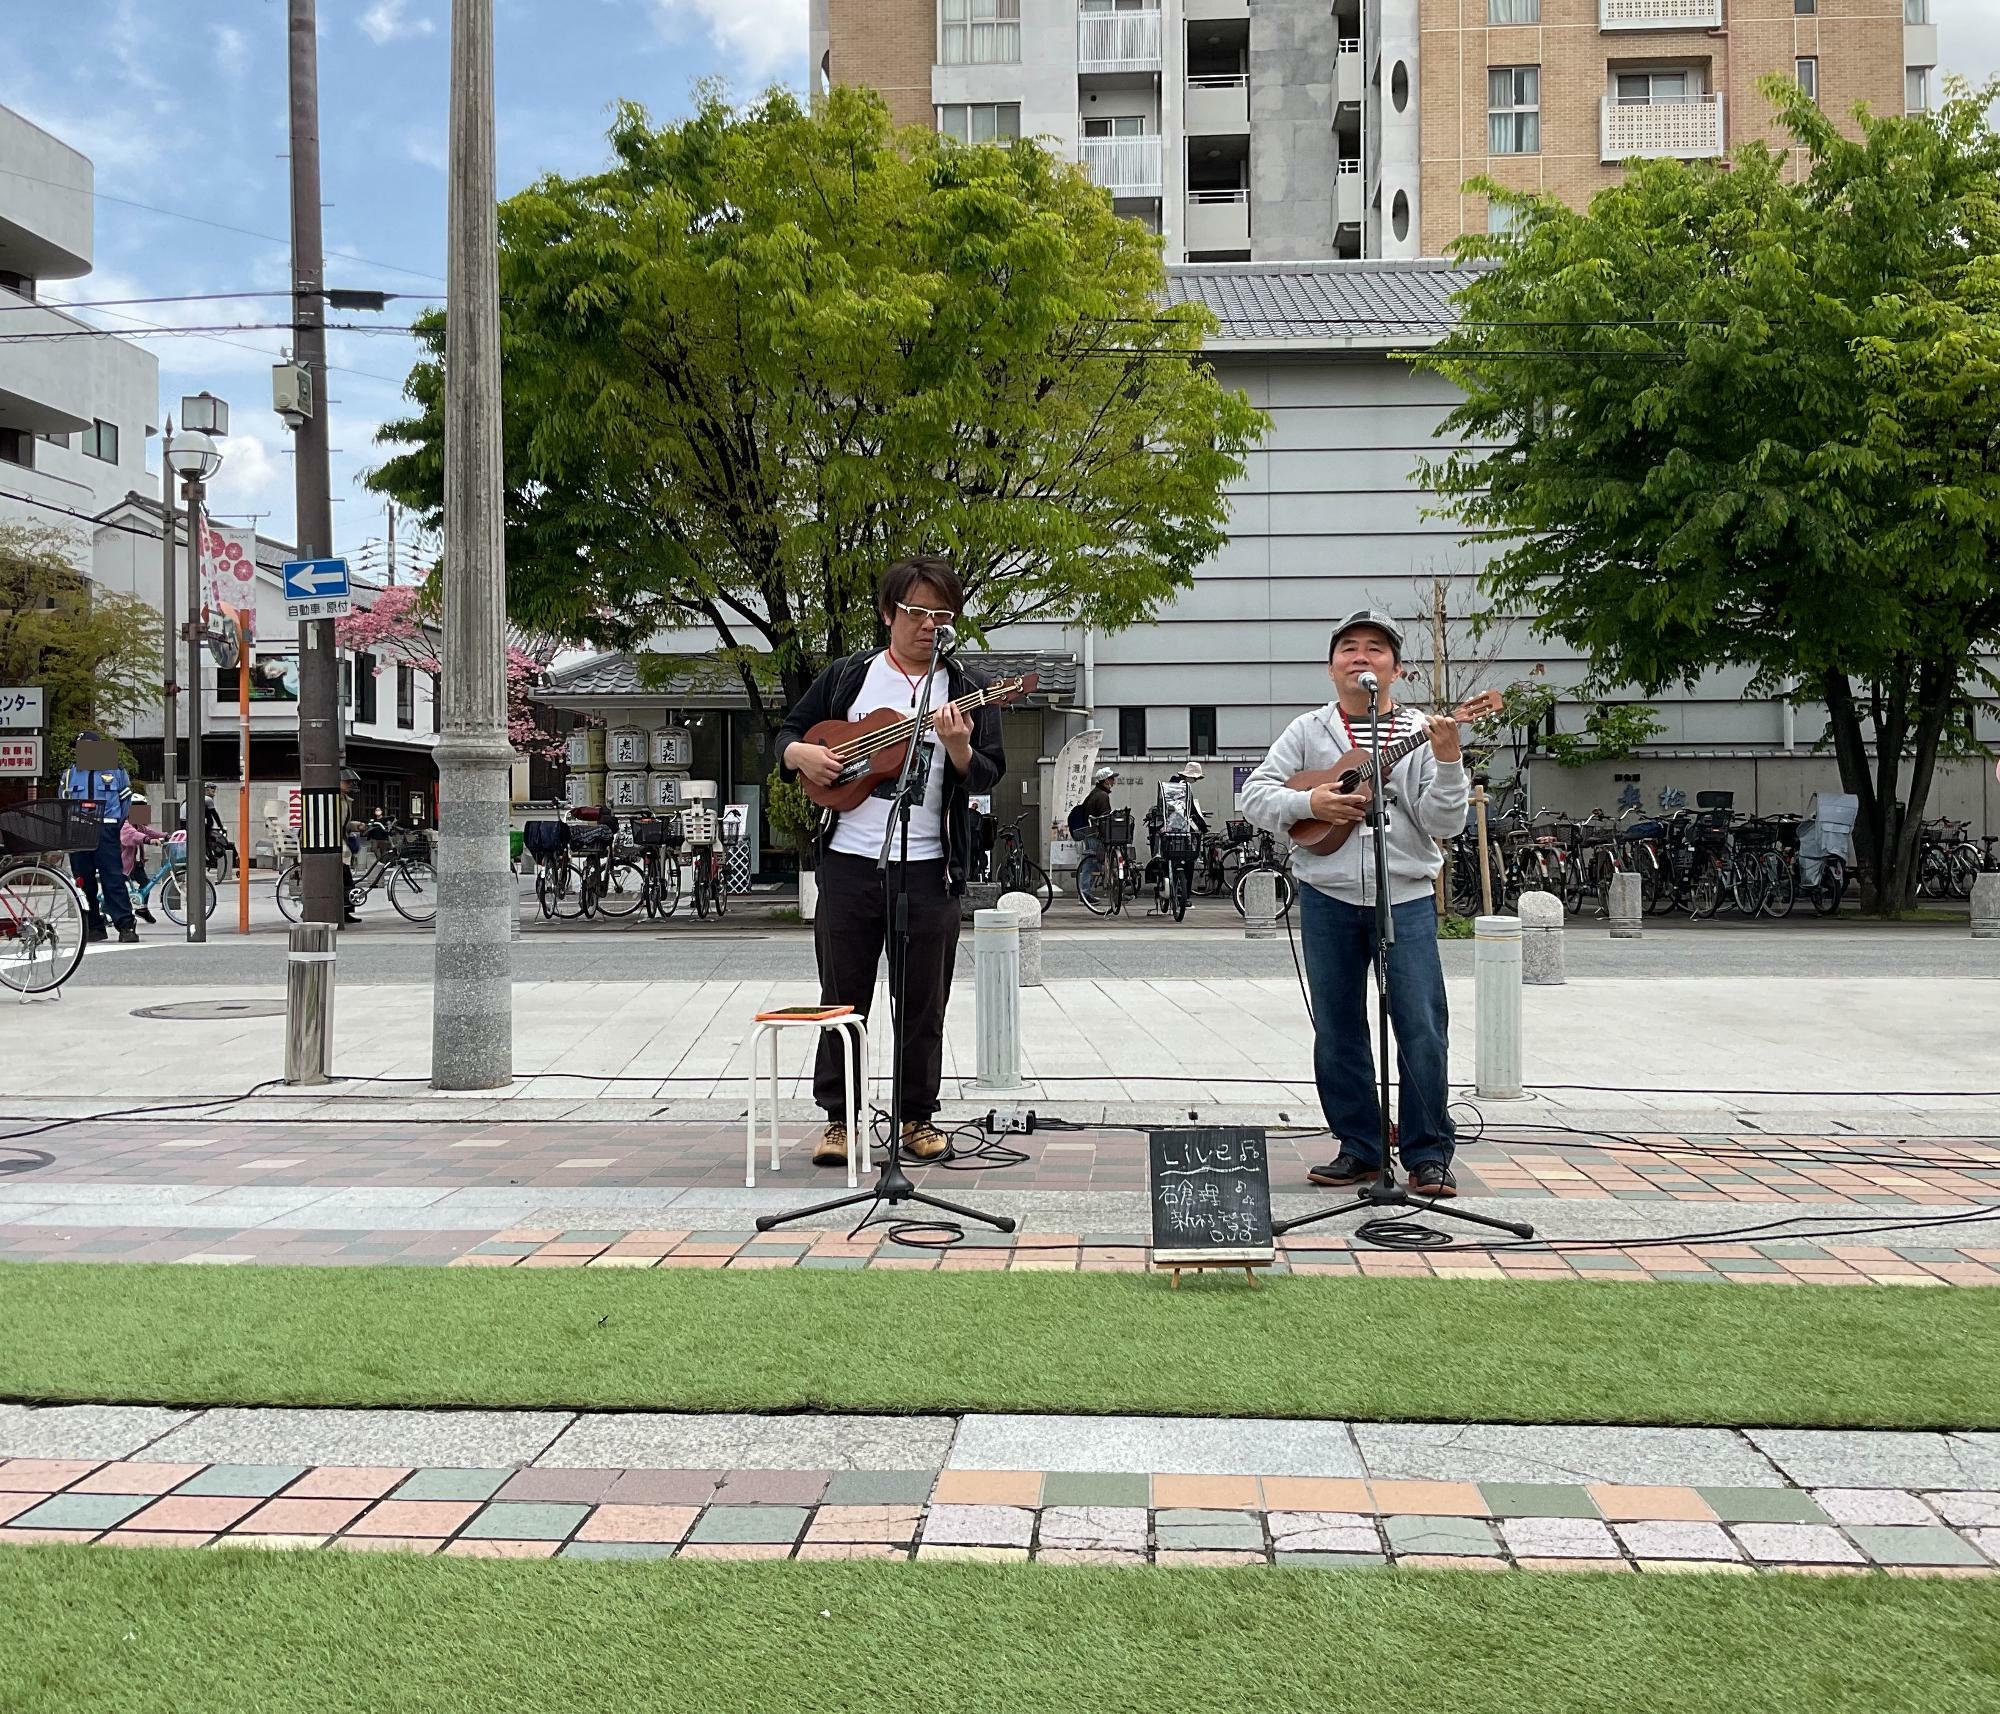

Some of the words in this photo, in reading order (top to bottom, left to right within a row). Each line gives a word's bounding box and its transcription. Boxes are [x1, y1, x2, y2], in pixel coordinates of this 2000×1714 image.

[0, 693, 37, 712] ンター
[619, 738, 632, 762] 老松
[662, 739, 675, 763] 老松
[619, 781, 632, 804] 老松
[662, 781, 675, 804] 老松
[1162, 1143, 1231, 1165] Live
